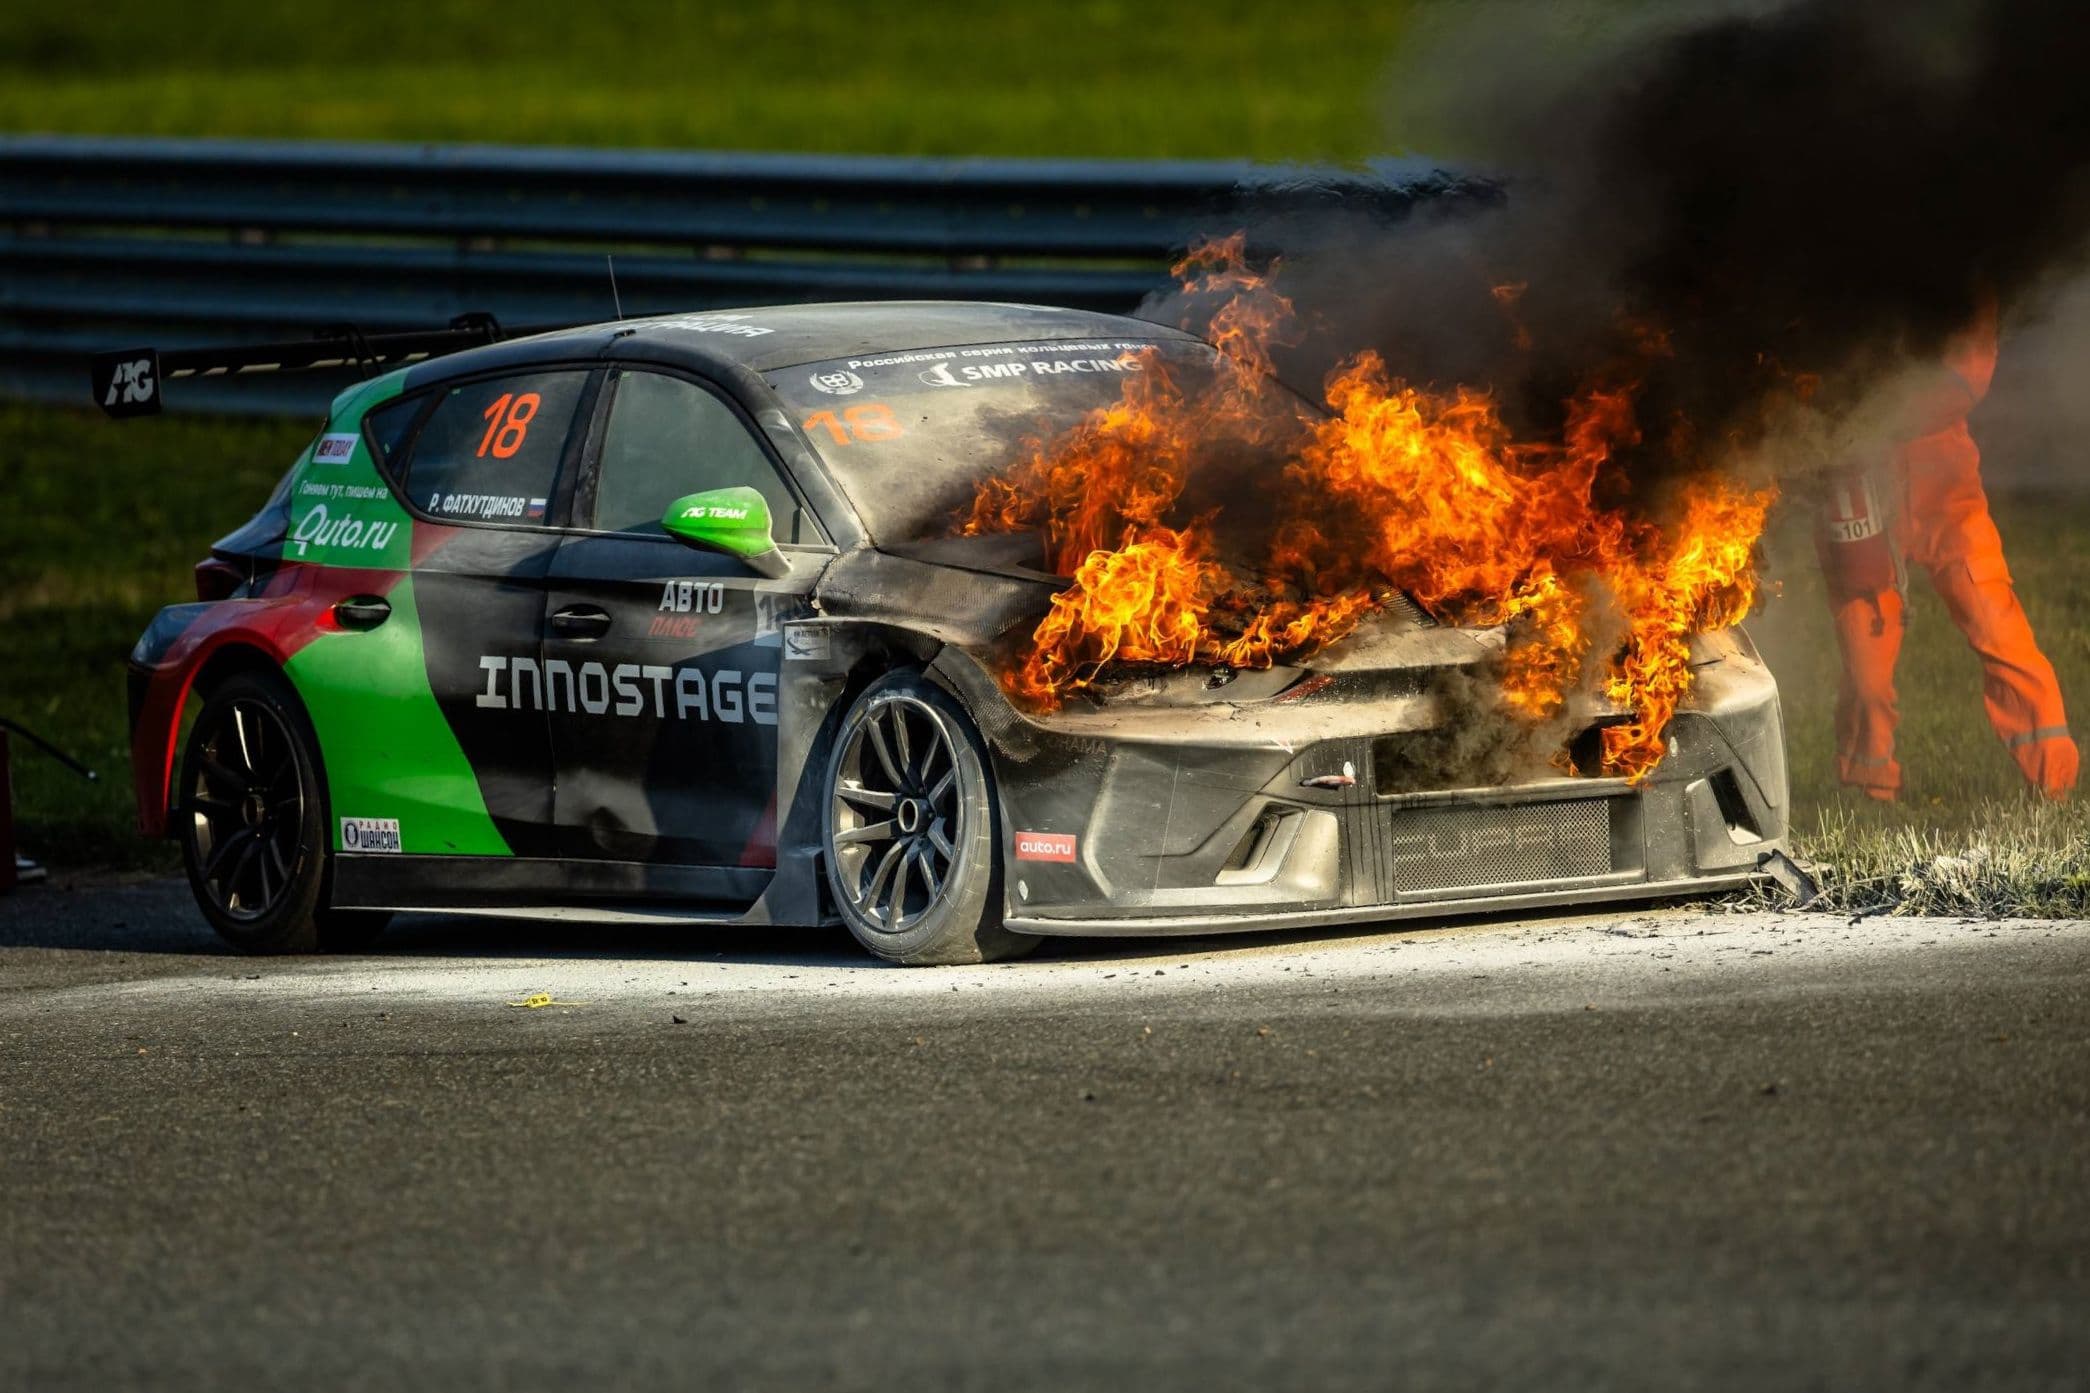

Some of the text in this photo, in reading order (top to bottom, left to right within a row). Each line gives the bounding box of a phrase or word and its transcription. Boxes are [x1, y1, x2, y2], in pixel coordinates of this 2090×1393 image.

[848, 352, 957, 370] Российская
[961, 346, 1014, 357] серия
[962, 359, 1144, 380] SMP RACING
[476, 393, 540, 459] 18
[803, 403, 903, 446] 18
[428, 493, 525, 518] Р. ФАТХУТДИНОВ
[709, 507, 748, 519] TEAM
[294, 504, 397, 556] Quto.ru
[658, 580, 724, 614] АВТО
[476, 656, 777, 725] INNOSTAGE
[360, 830, 399, 849] ШАНСОН
[1020, 841, 1071, 855] auto.ru
